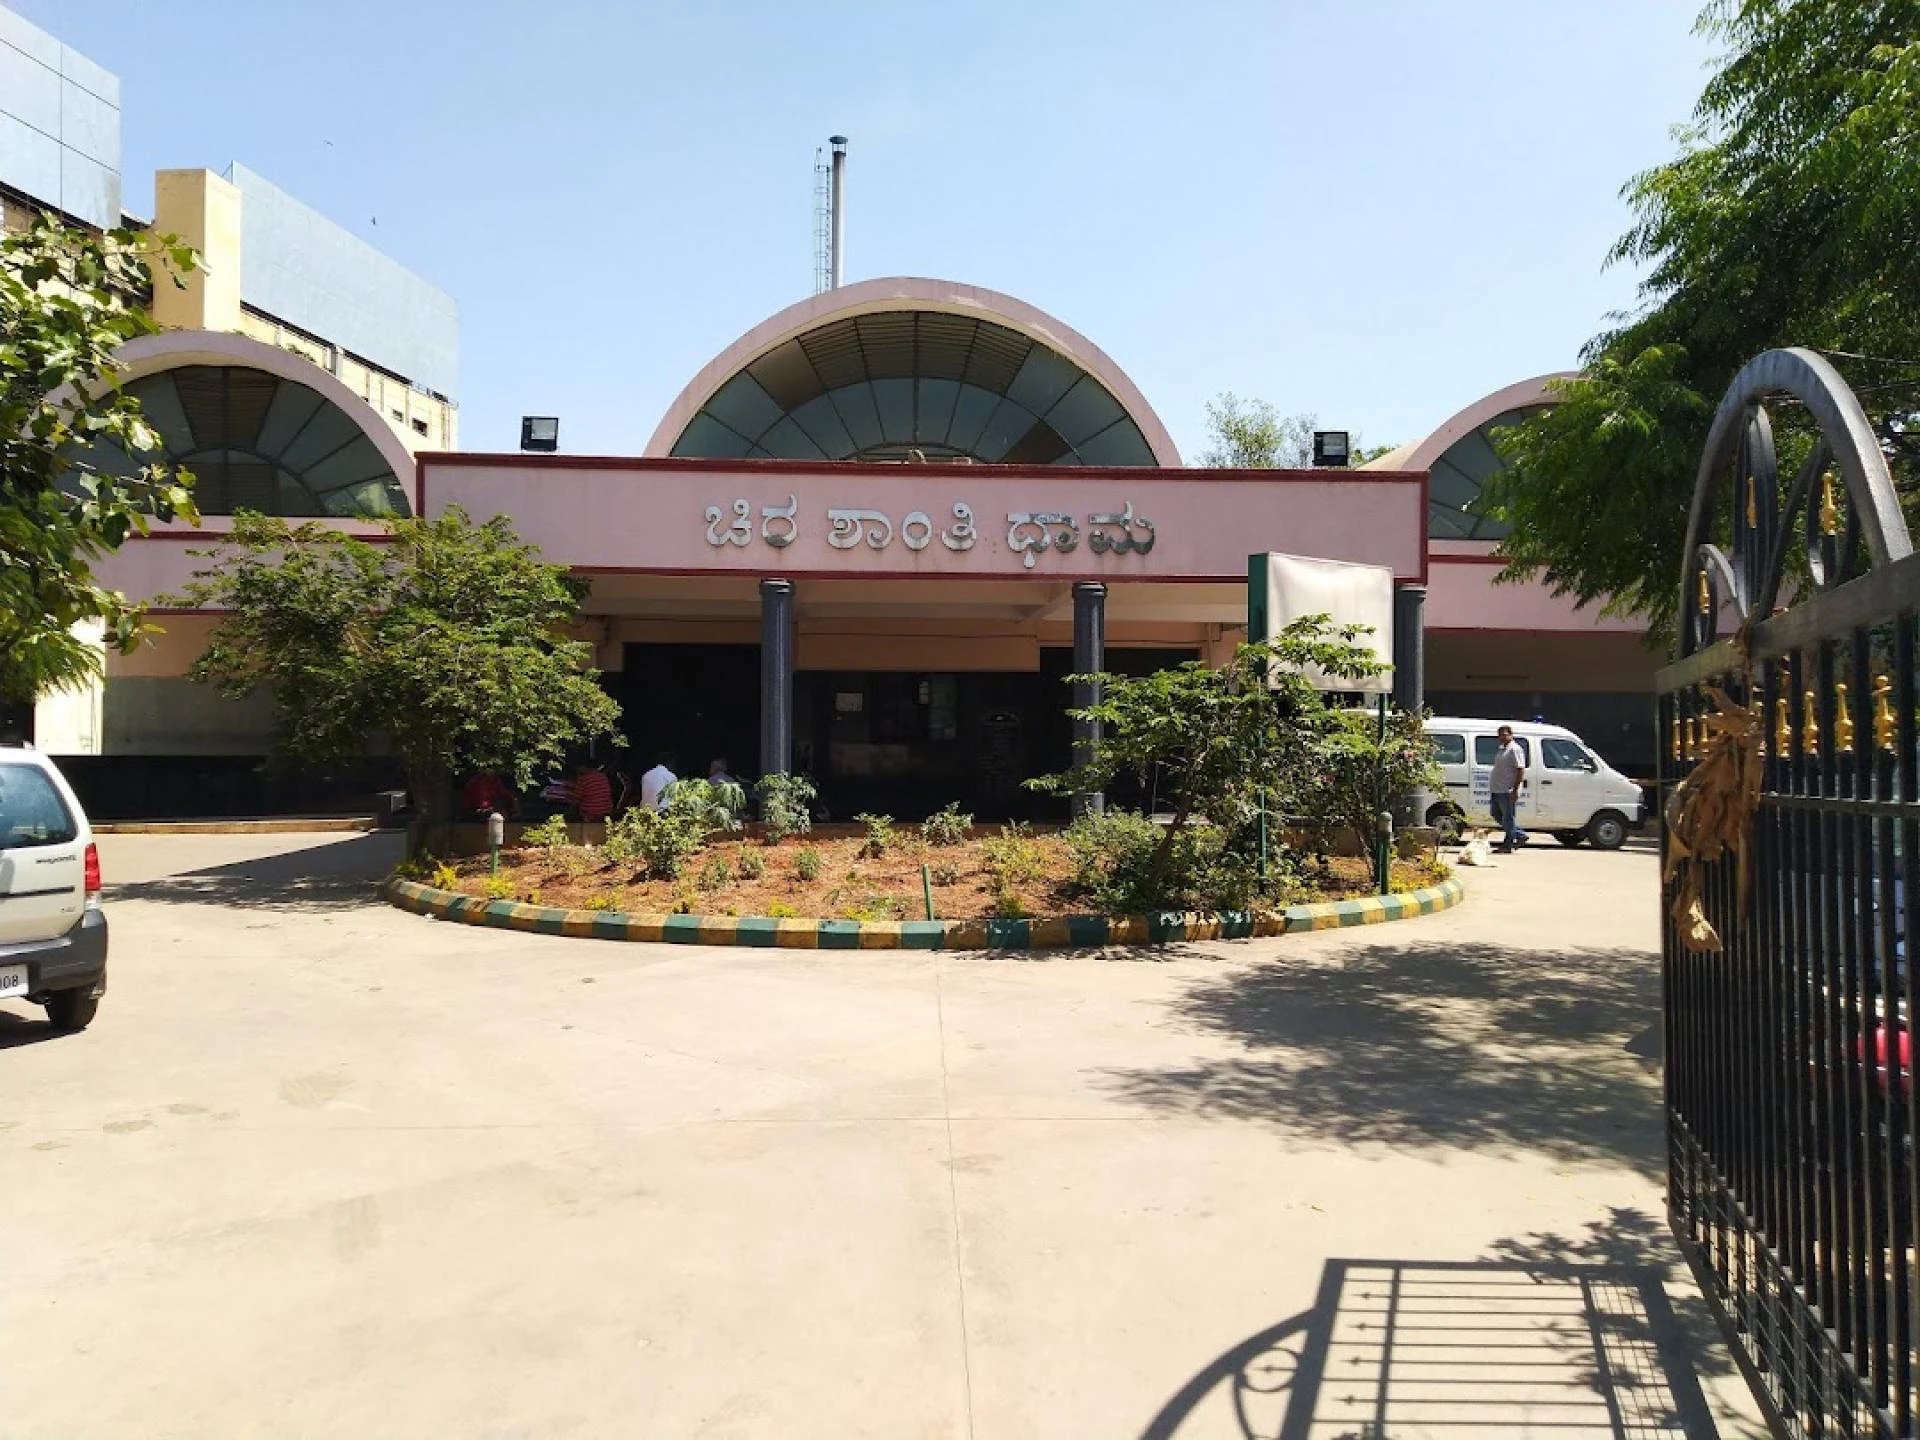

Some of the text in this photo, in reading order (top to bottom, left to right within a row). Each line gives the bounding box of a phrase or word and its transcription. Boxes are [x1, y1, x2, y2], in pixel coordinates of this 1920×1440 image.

[704, 494, 1155, 569] ಚಿರ ಶಾಂತಿ ಧಾಮ
[0, 974, 19, 989] 08
